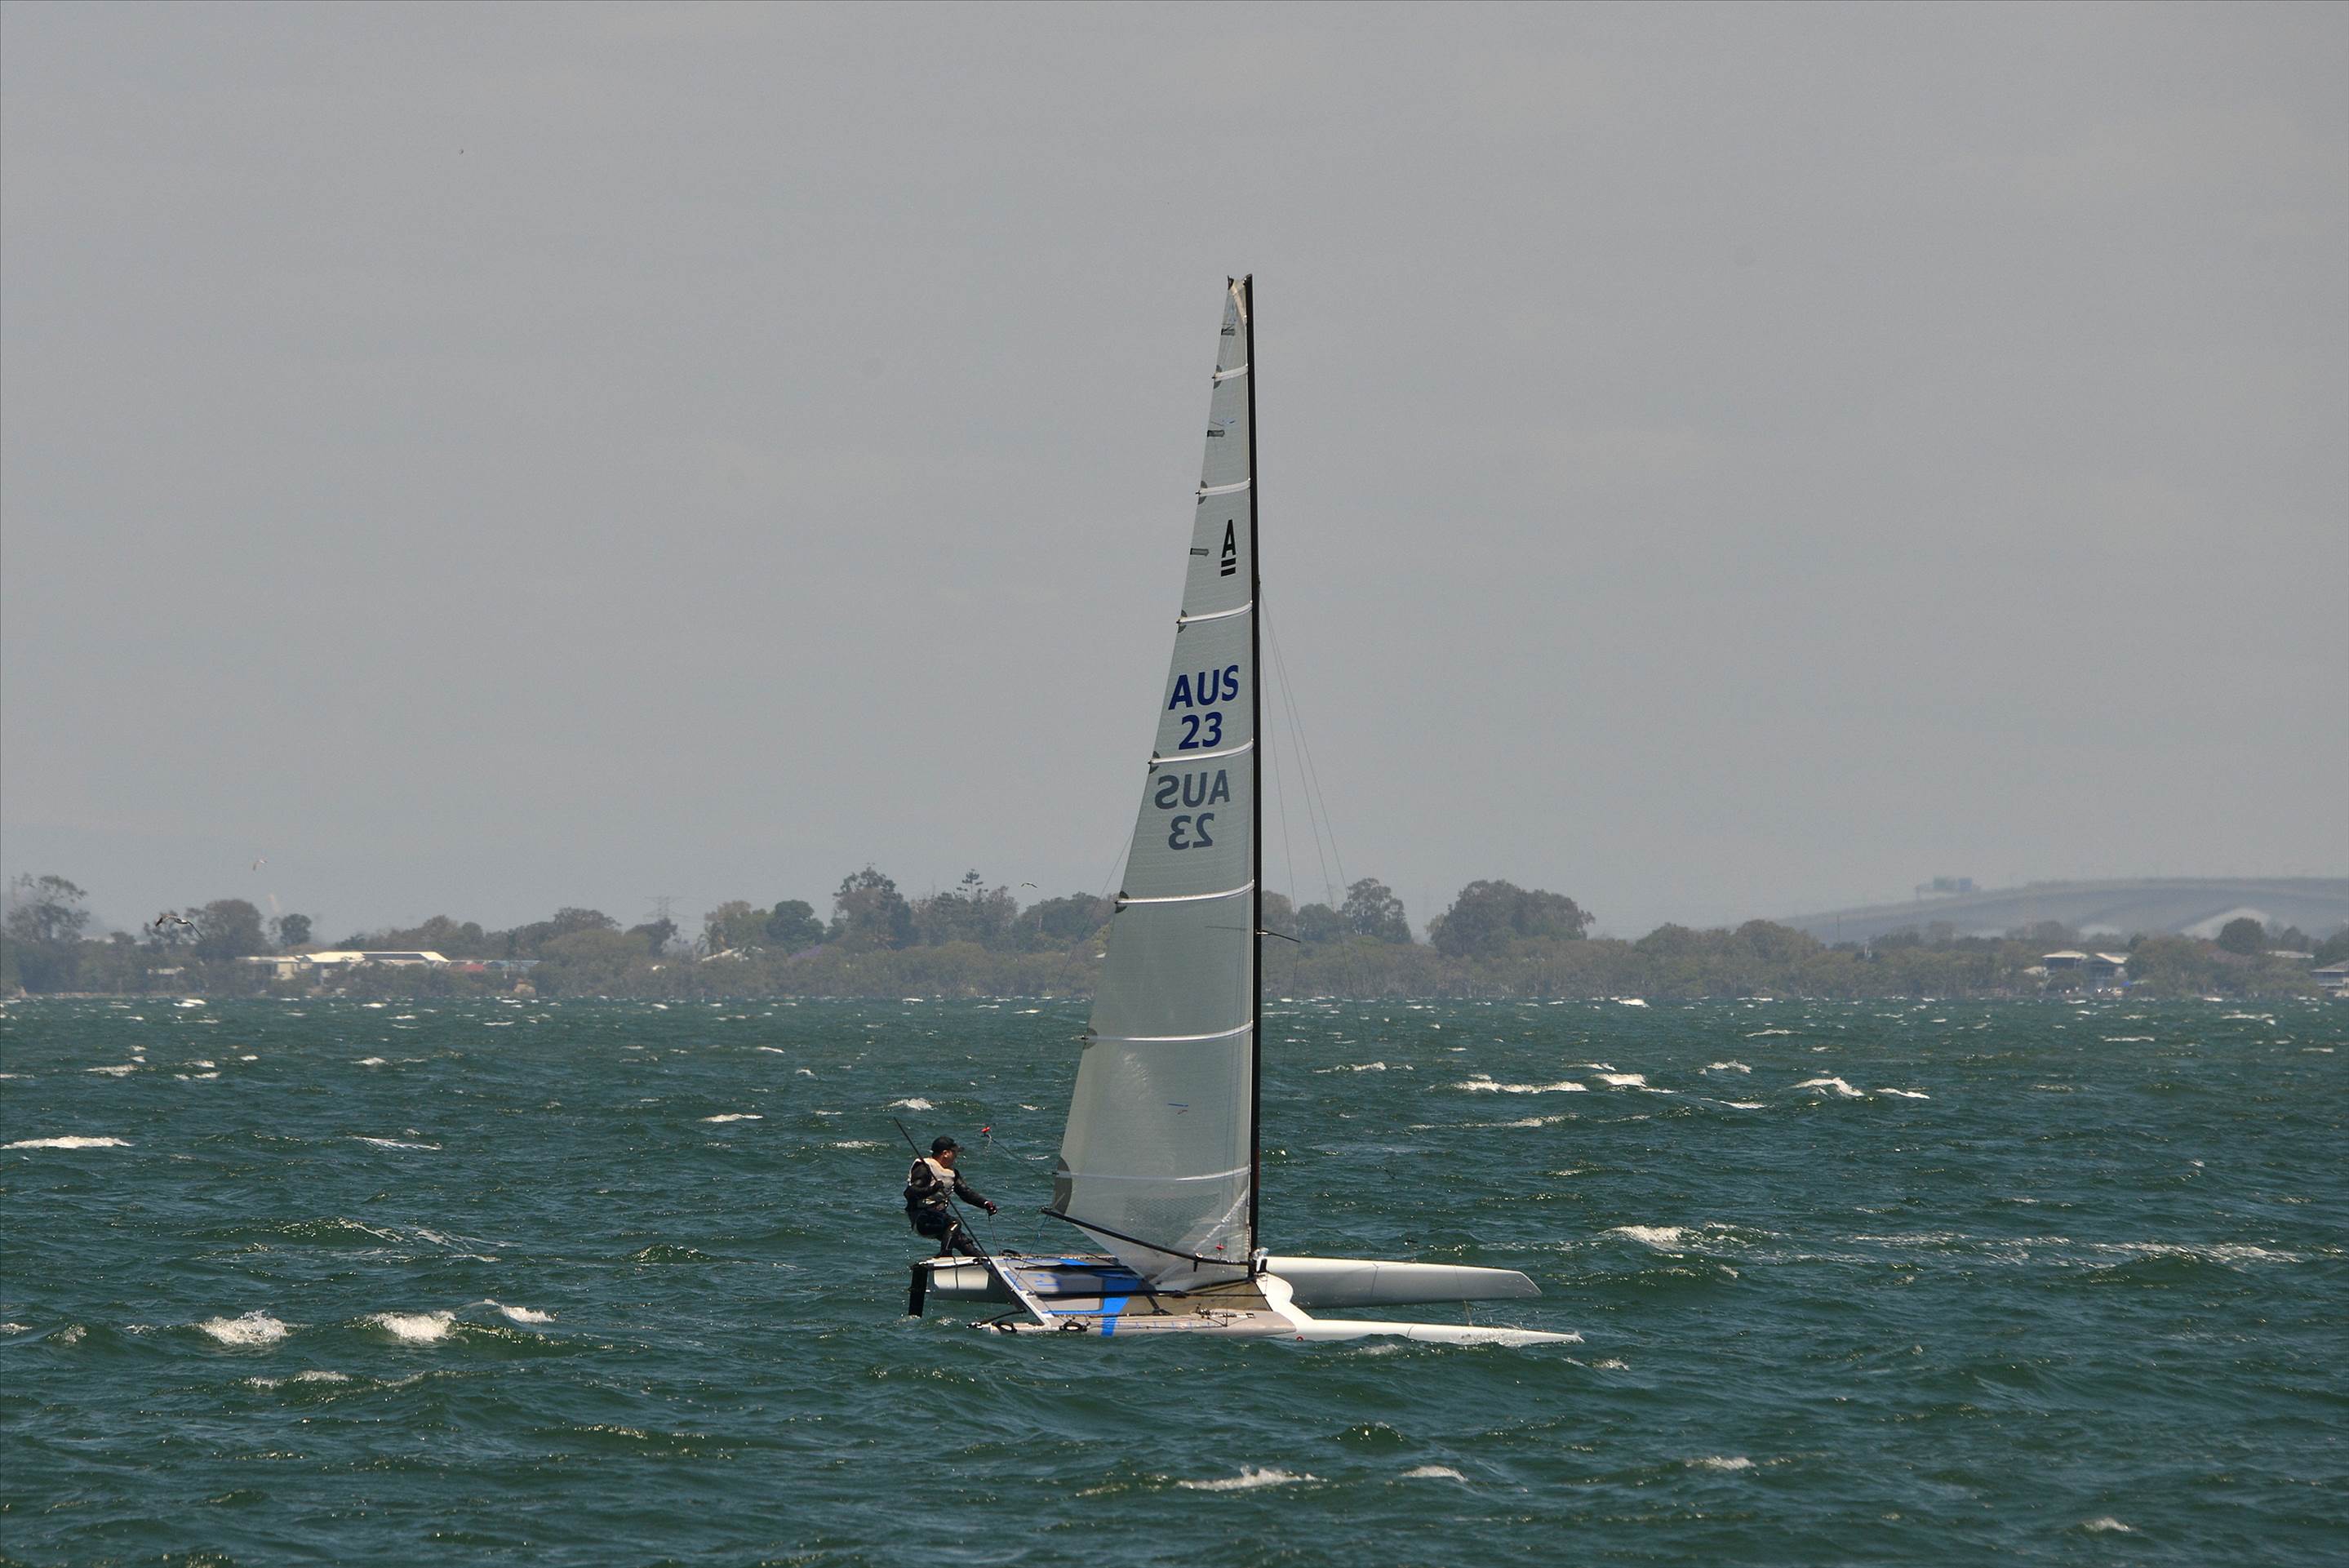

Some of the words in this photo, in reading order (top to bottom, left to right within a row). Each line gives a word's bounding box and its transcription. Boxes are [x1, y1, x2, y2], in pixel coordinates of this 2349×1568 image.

[1221, 518, 1237, 557] A
[1168, 664, 1239, 710] AUS
[1178, 711, 1223, 750] 23
